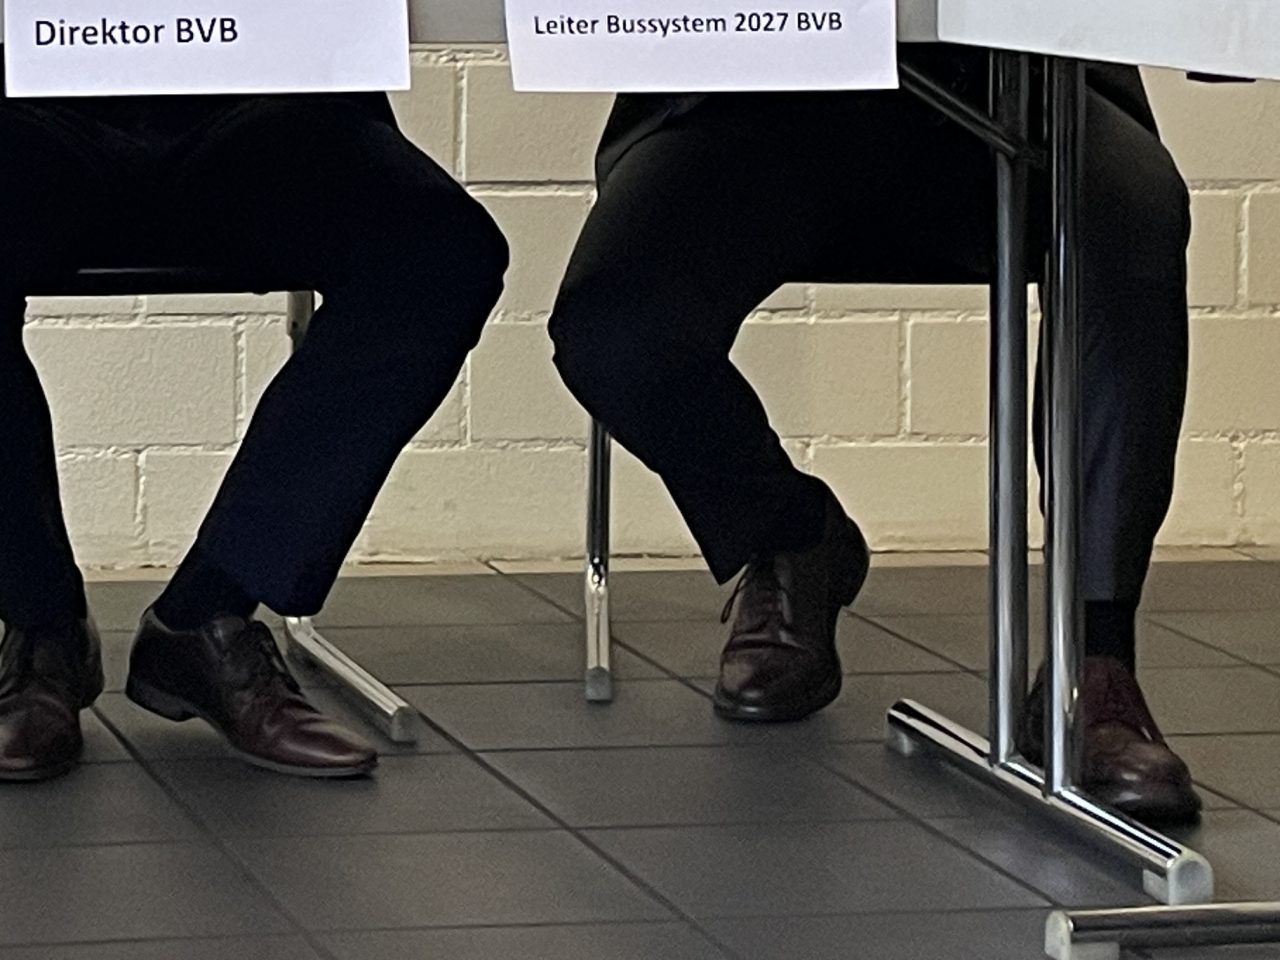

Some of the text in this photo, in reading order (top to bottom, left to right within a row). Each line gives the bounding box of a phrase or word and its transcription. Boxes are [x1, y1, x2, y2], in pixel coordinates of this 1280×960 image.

[35, 17, 238, 46] Direktor BVB
[534, 11, 843, 38] Leiter Bussystem 2027 BVB
